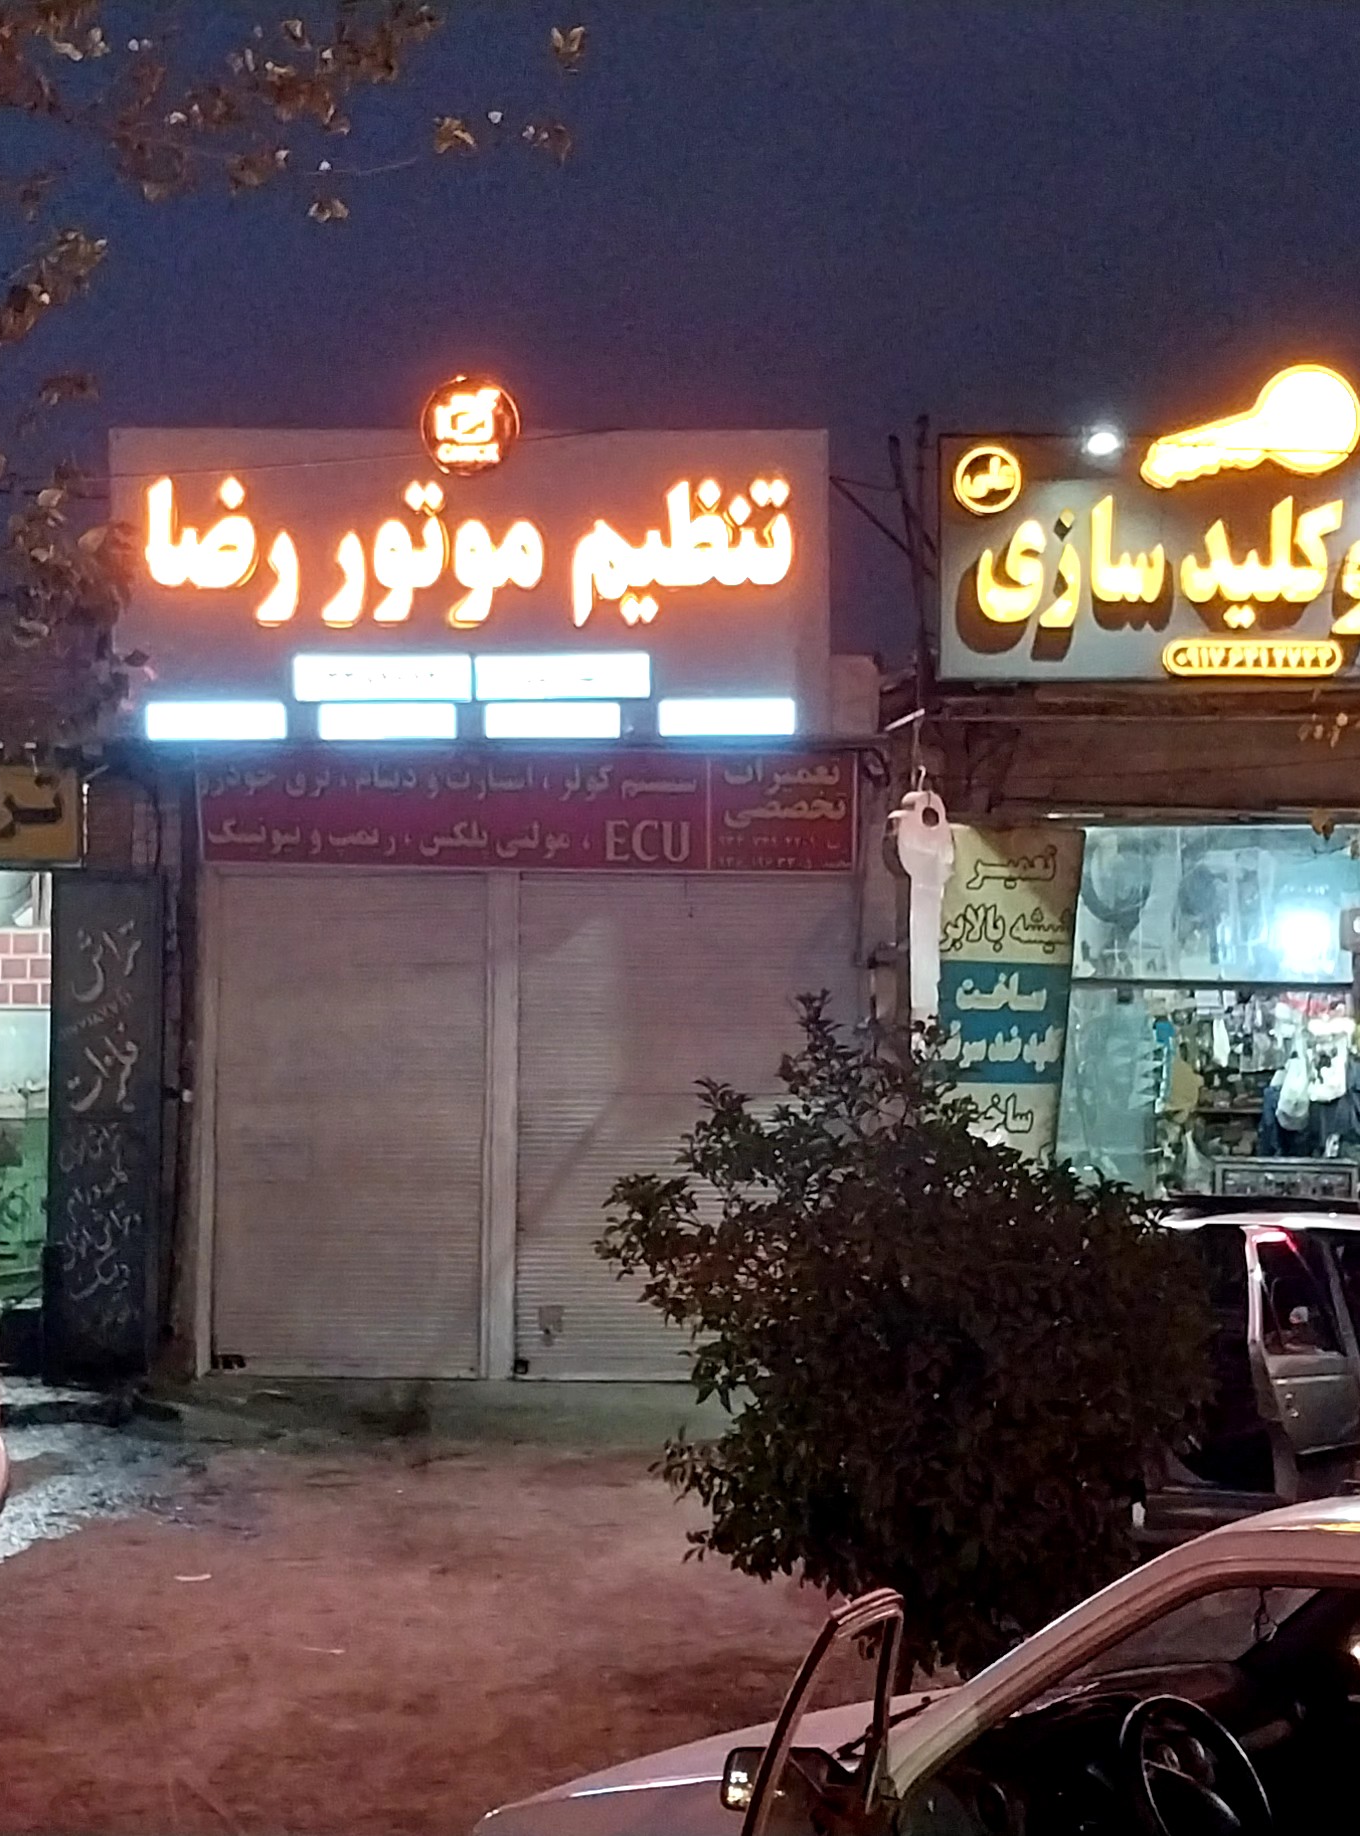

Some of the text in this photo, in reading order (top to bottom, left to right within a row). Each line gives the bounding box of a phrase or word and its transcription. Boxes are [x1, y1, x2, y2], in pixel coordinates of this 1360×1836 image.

[146, 475, 793, 628] تنظیم موتور رضا
[976, 496, 1166, 628] سازی
[1180, 496, 1343, 628] کلید
[558, 763, 615, 801] کولر
[723, 756, 840, 796] تعمیرات
[723, 790, 847, 829] تخصصی
[605, 819, 691, 863] ECU
[965, 845, 1058, 890] تعمیر
[955, 972, 1048, 1012] ساخت
